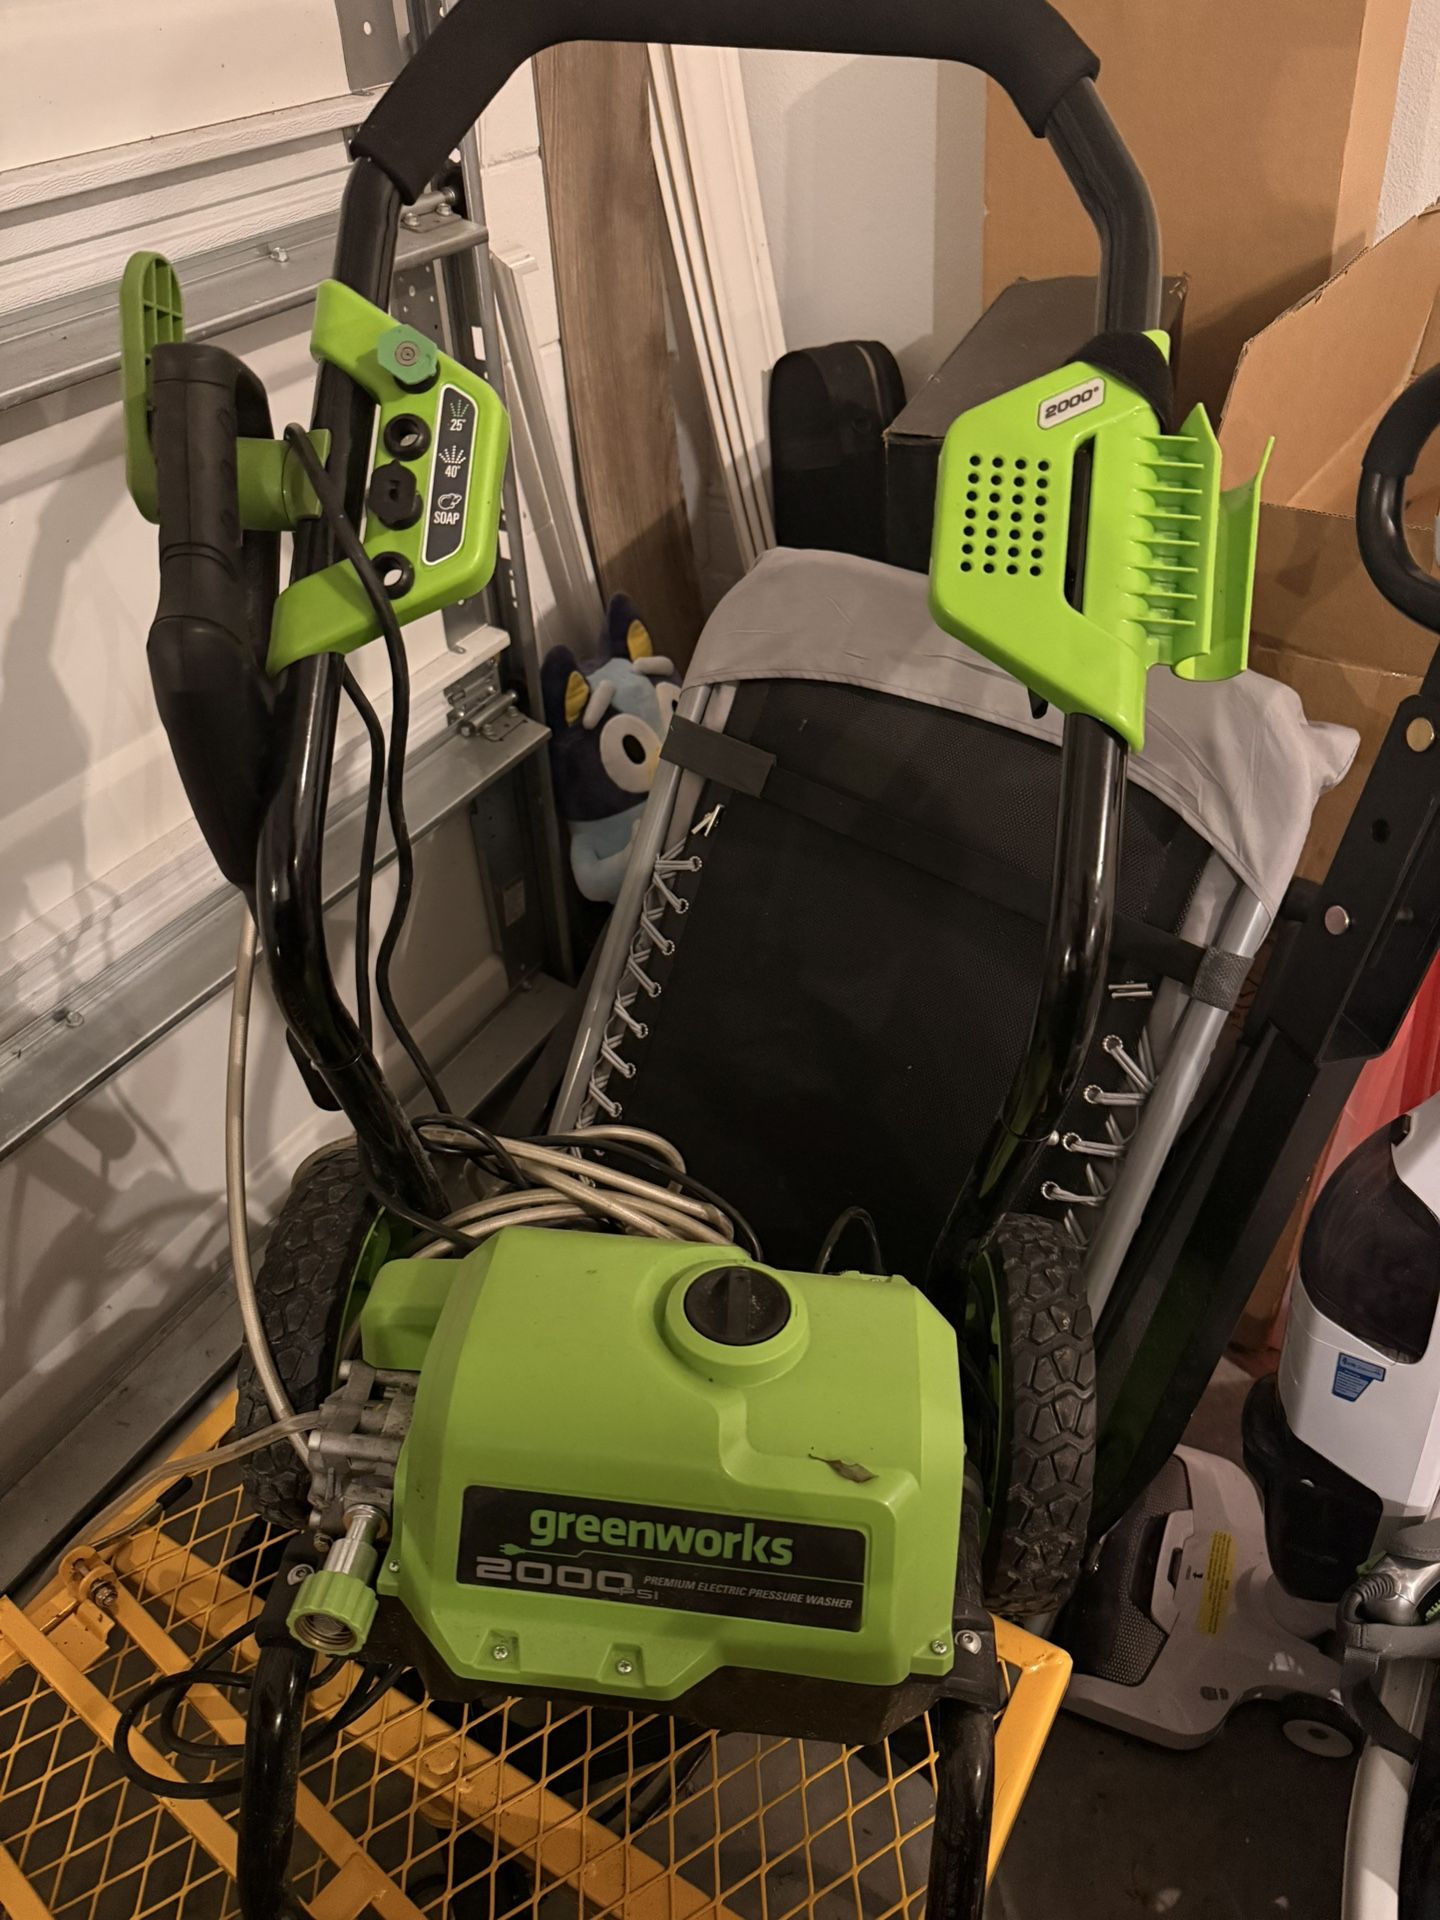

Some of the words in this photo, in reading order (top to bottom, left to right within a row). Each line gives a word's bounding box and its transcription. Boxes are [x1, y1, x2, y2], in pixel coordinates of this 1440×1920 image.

[433, 510, 460, 525] SOAP
[529, 1508, 794, 1566] greenworks
[476, 1556, 634, 1595] 2000
[619, 1586, 659, 1601] PSI
[643, 1575, 696, 1591] PREMIUM
[697, 1581, 749, 1597] ELECTRIC
[748, 1588, 804, 1604] PRESSURE
[806, 1594, 854, 1609] WASHER
